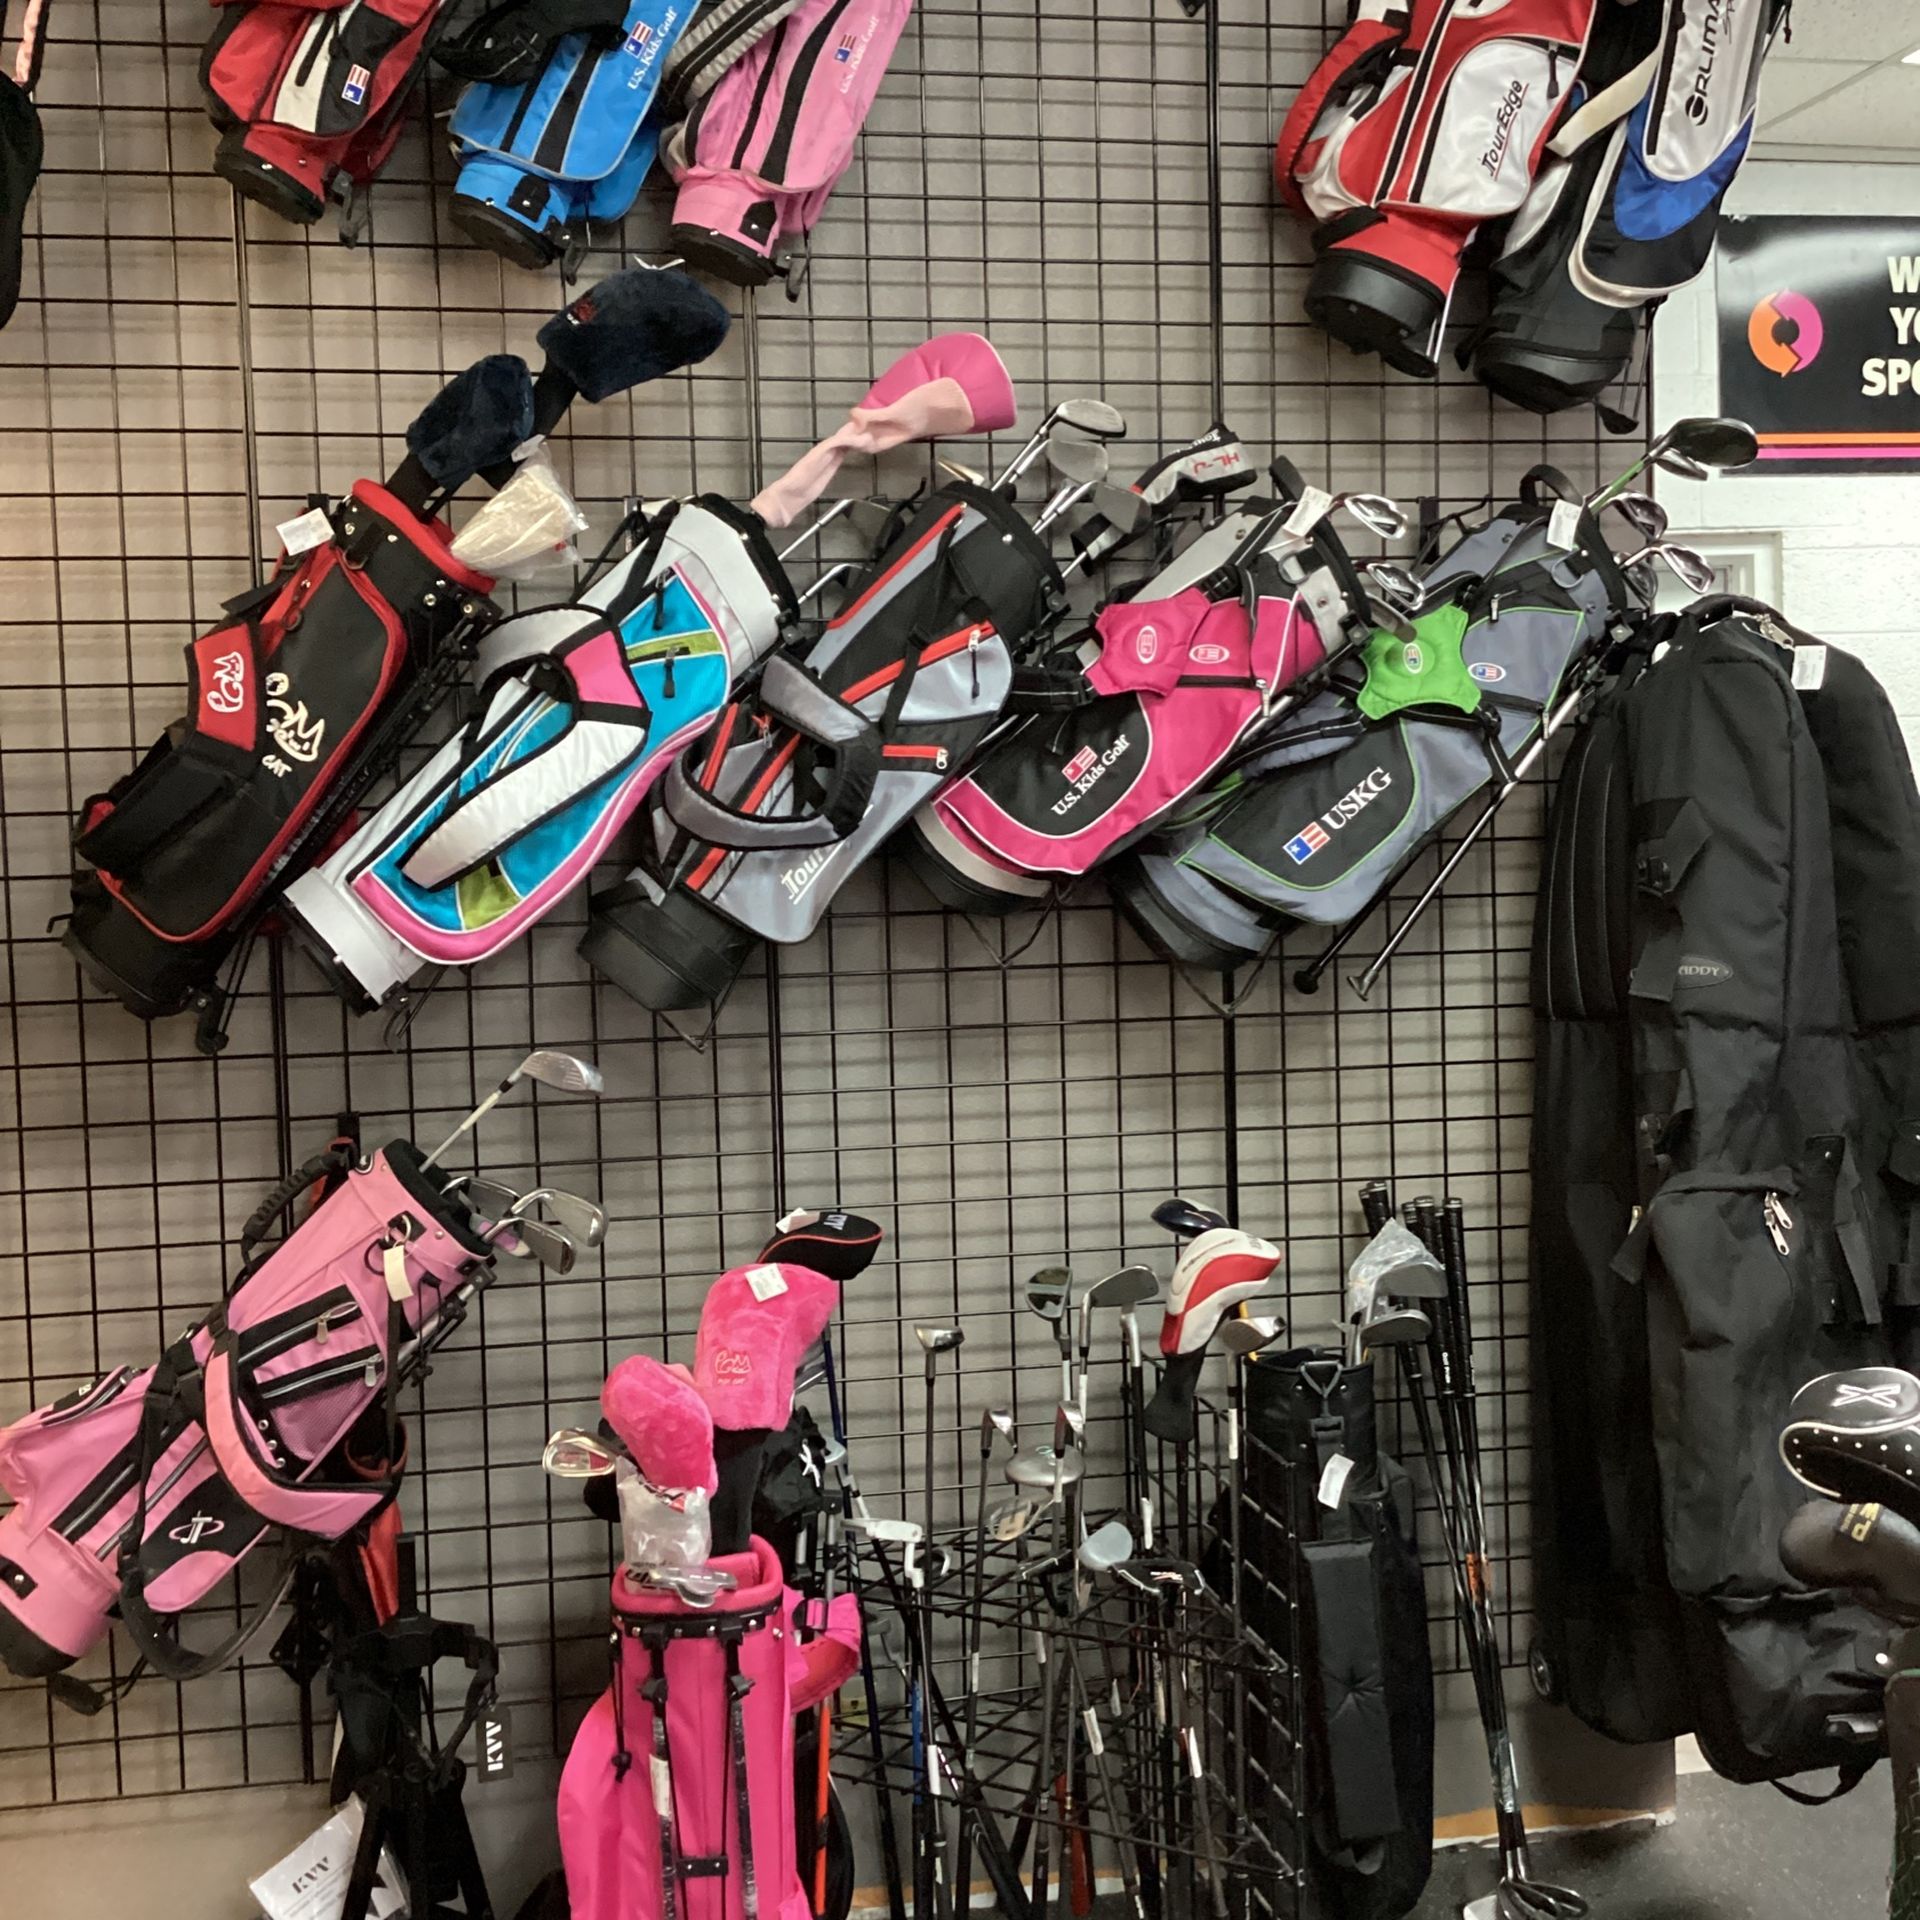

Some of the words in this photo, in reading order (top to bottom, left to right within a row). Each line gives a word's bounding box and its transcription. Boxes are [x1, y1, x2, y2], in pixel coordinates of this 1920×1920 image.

[262, 754, 293, 778] CAT
[1074, 764, 1106, 795] Kids
[1101, 733, 1131, 766] Golf
[1320, 766, 1392, 830] USKG
